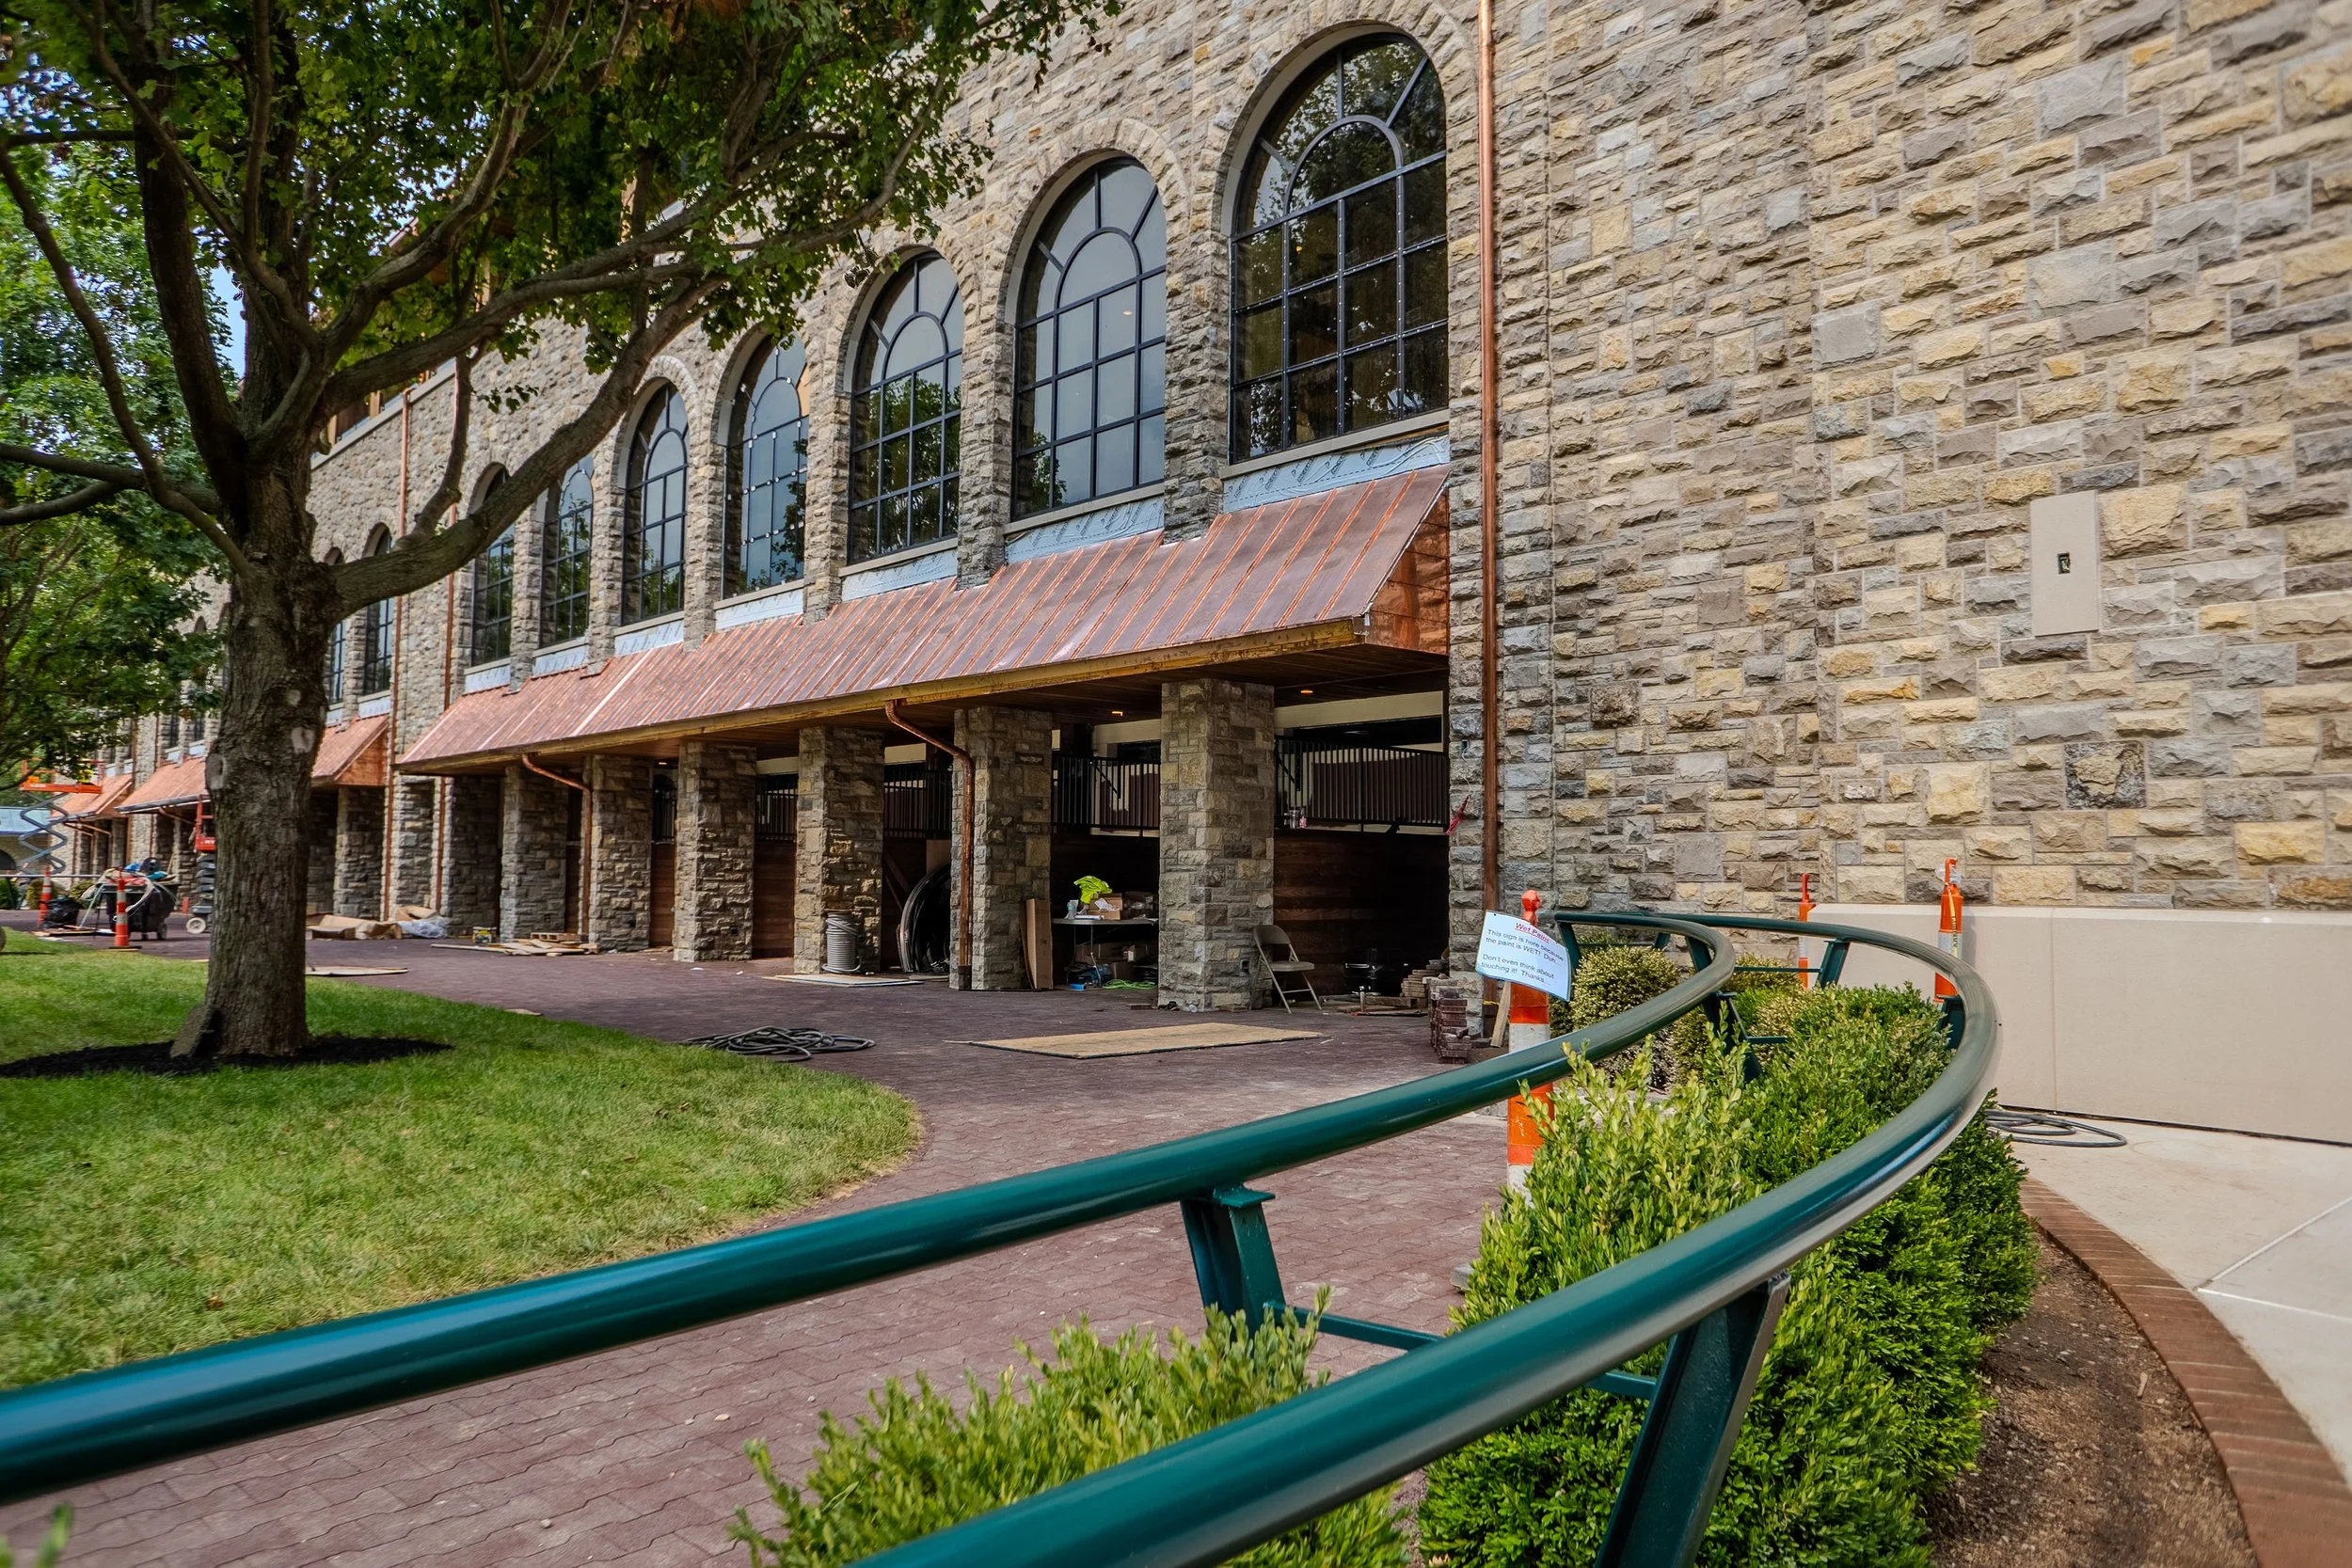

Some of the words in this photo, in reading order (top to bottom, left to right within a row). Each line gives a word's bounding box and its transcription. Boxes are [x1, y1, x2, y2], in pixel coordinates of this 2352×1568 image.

[1516, 922, 1531, 932] Wet
[1533, 929, 1549, 943] Paint
[1498, 940, 1515, 948] paint
[1523, 944, 1541, 956] WET!
[1525, 938, 1540, 948] here
[1541, 943, 1564, 960] because
[1481, 962, 1510, 973] touching
[1483, 954, 1501, 962] Don't
[1502, 958, 1518, 966] even
[1519, 961, 1535, 972] think
[1536, 968, 1554, 979] about
